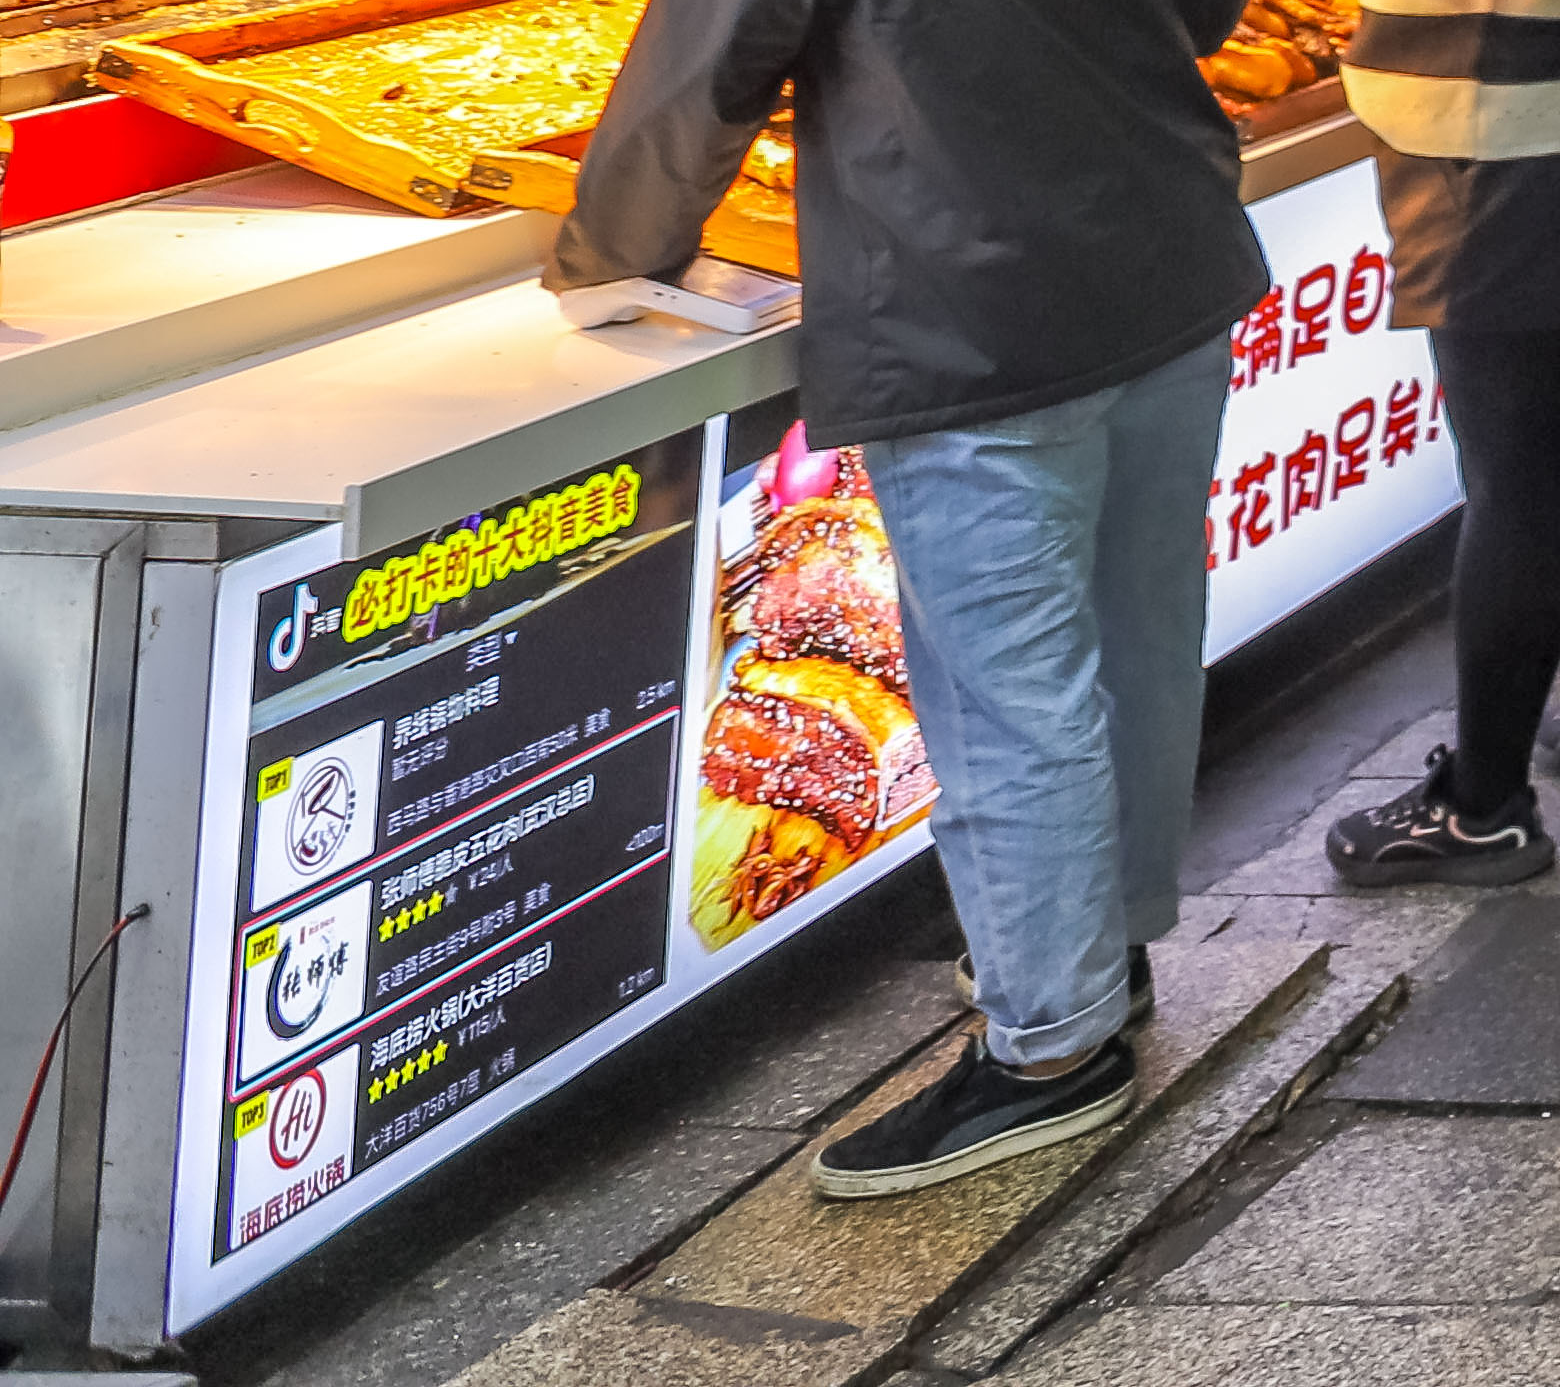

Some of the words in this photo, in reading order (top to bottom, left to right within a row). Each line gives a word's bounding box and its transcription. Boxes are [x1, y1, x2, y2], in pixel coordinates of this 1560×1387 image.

[349, 468, 637, 631] 必打卡的十大抖音美食
[369, 939, 554, 1073] 海底捞火锅(大洋百货店)
[241, 1101, 266, 1131] TOP3
[239, 1153, 346, 1245] 海底捞火锅
